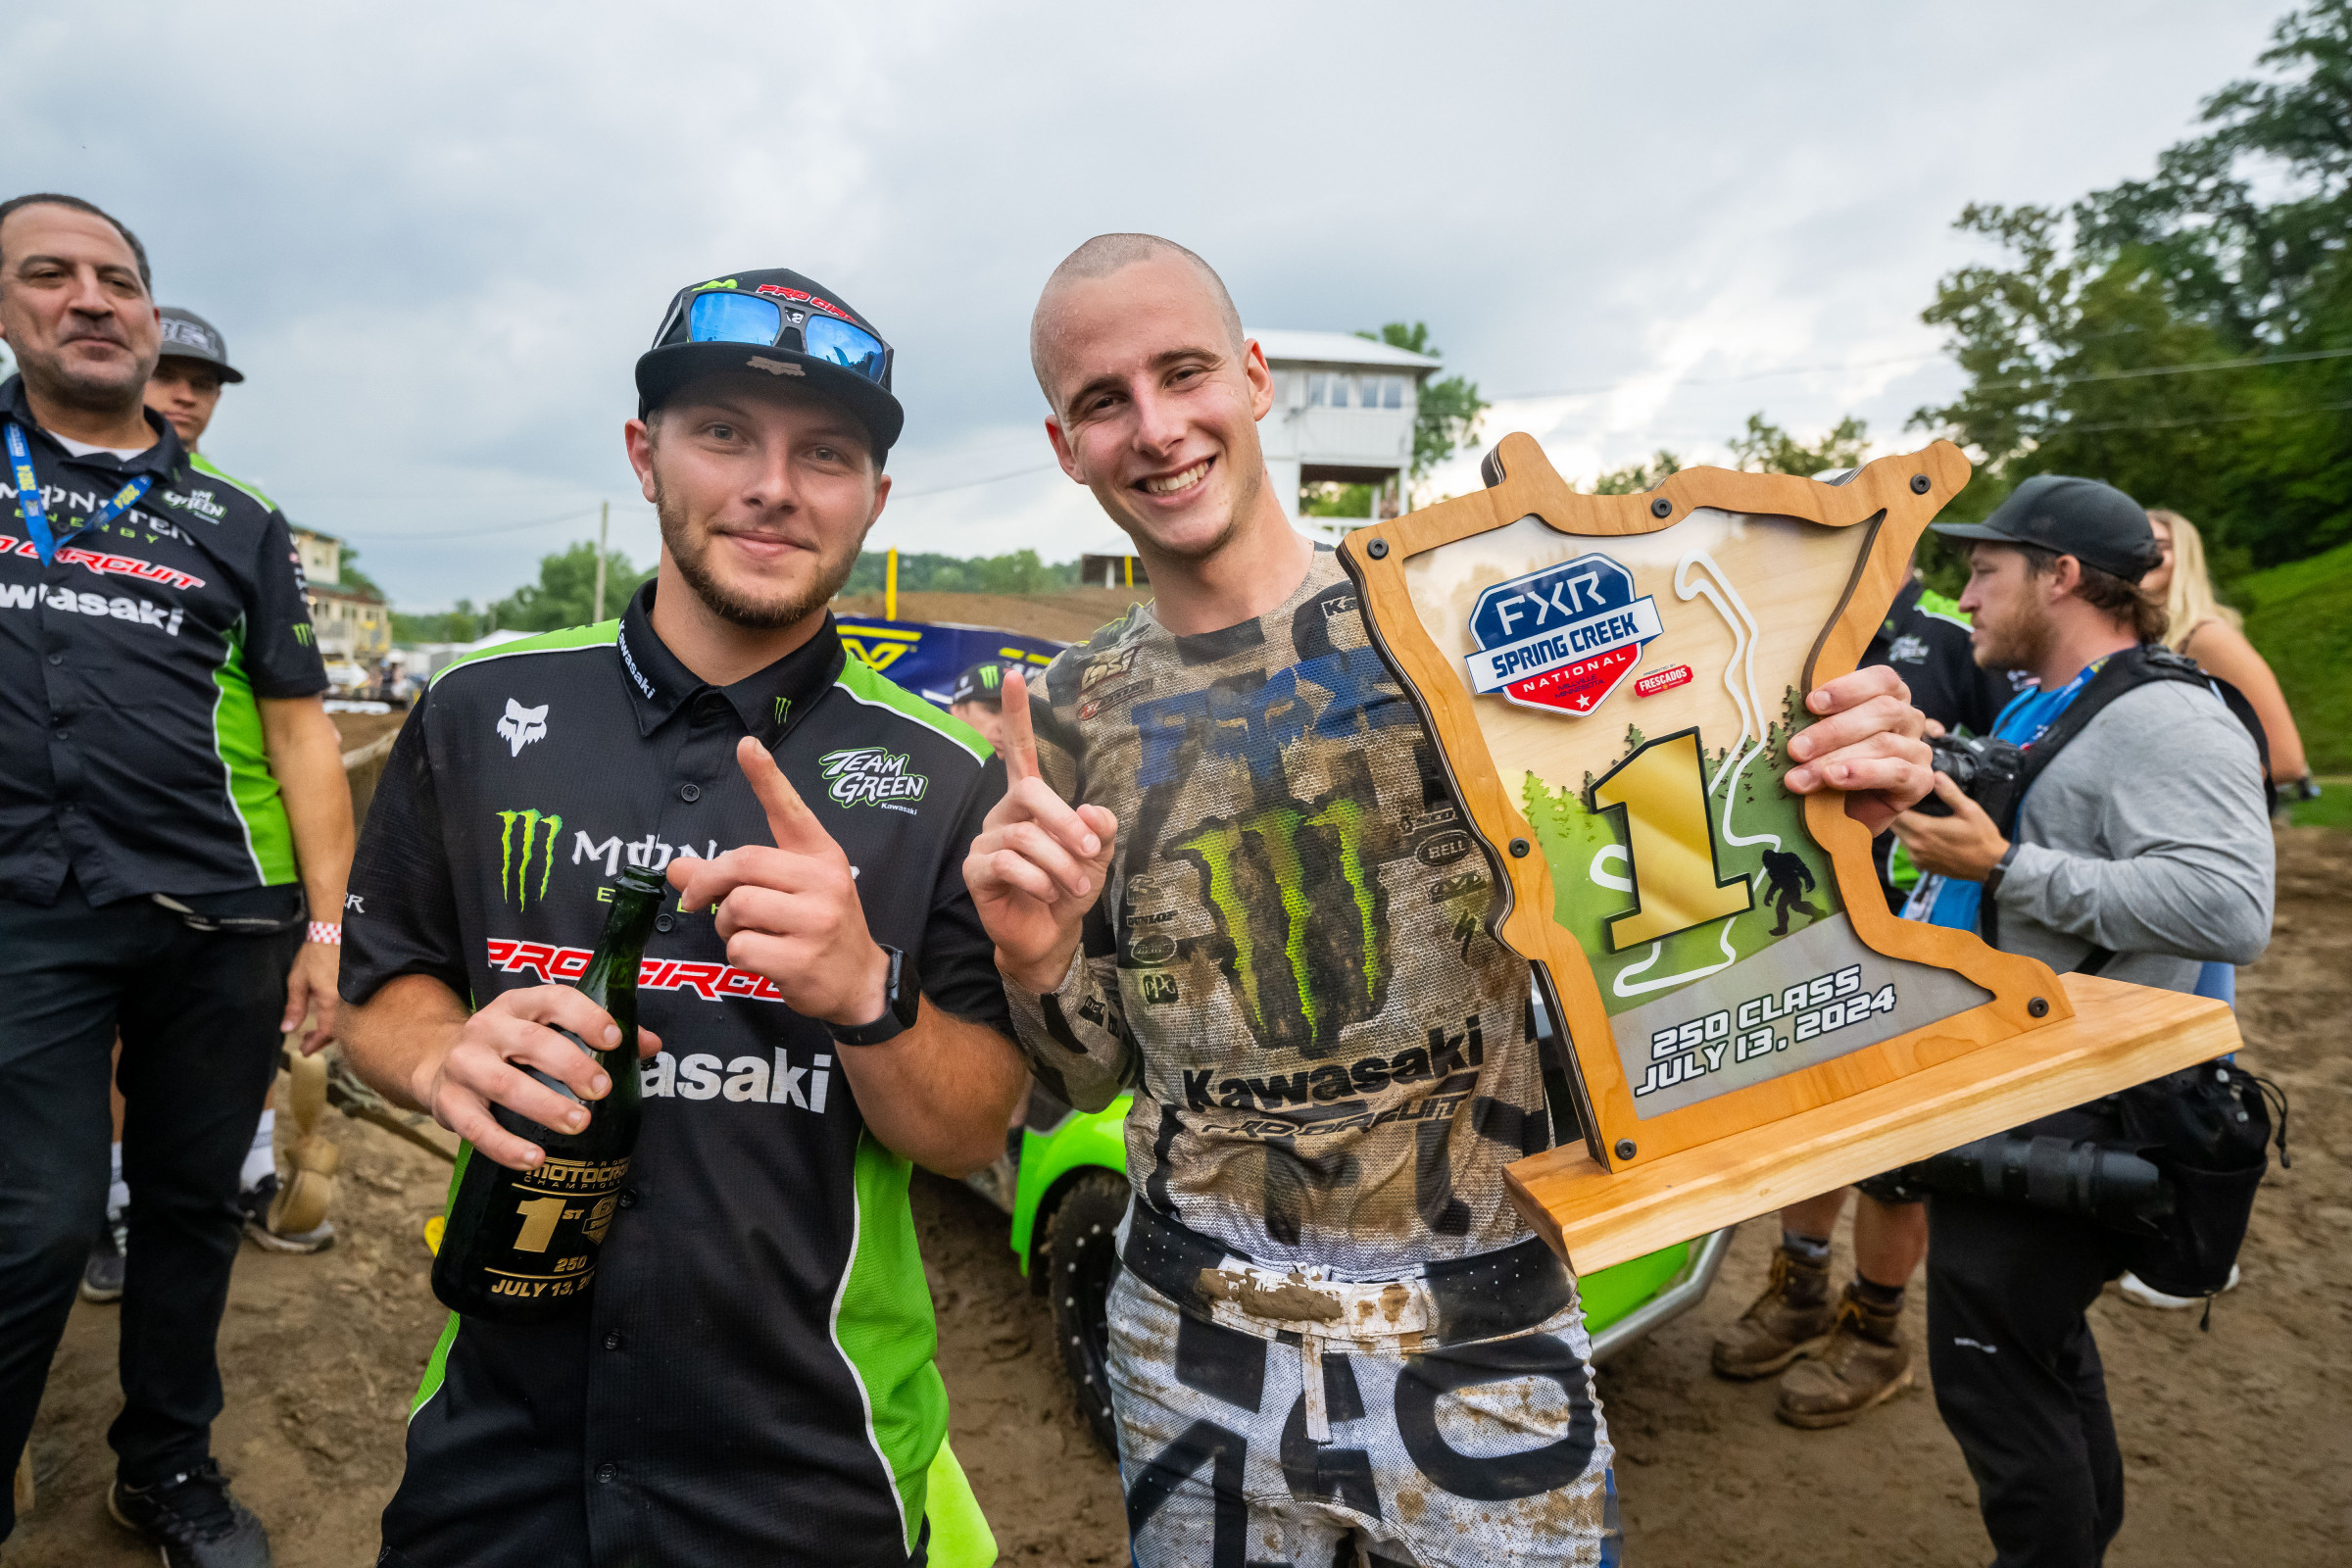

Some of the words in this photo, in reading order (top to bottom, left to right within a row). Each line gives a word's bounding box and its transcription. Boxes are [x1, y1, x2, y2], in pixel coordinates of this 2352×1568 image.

[756, 283, 811, 302] PRO
[809, 296, 859, 323] CIR
[1495, 570, 1607, 636] FXR
[618, 619, 657, 700] Kawasaki
[1491, 635, 1568, 679] SPRING
[1570, 611, 1641, 654] CREEK
[1522, 653, 1627, 693] NATIONAL
[1639, 667, 1688, 692] FRESCADOS
[822, 749, 906, 776] TEAM
[832, 771, 925, 804] GREEN
[881, 802, 918, 815] Kawasaki
[1428, 840, 1466, 858] BELL
[1590, 726, 1754, 955] 1
[486, 938, 595, 985] PRO
[1651, 1009, 1731, 1060] 250
[1737, 963, 1862, 1030] CLASS
[1635, 1040, 1729, 1098] JULY
[1794, 983, 1897, 1044] 2024
[640, 1046, 832, 1114] asaki
[1183, 1014, 1485, 1113] Kawasaki
[553, 1255, 588, 1273] 250
[491, 1279, 549, 1298] JULY
